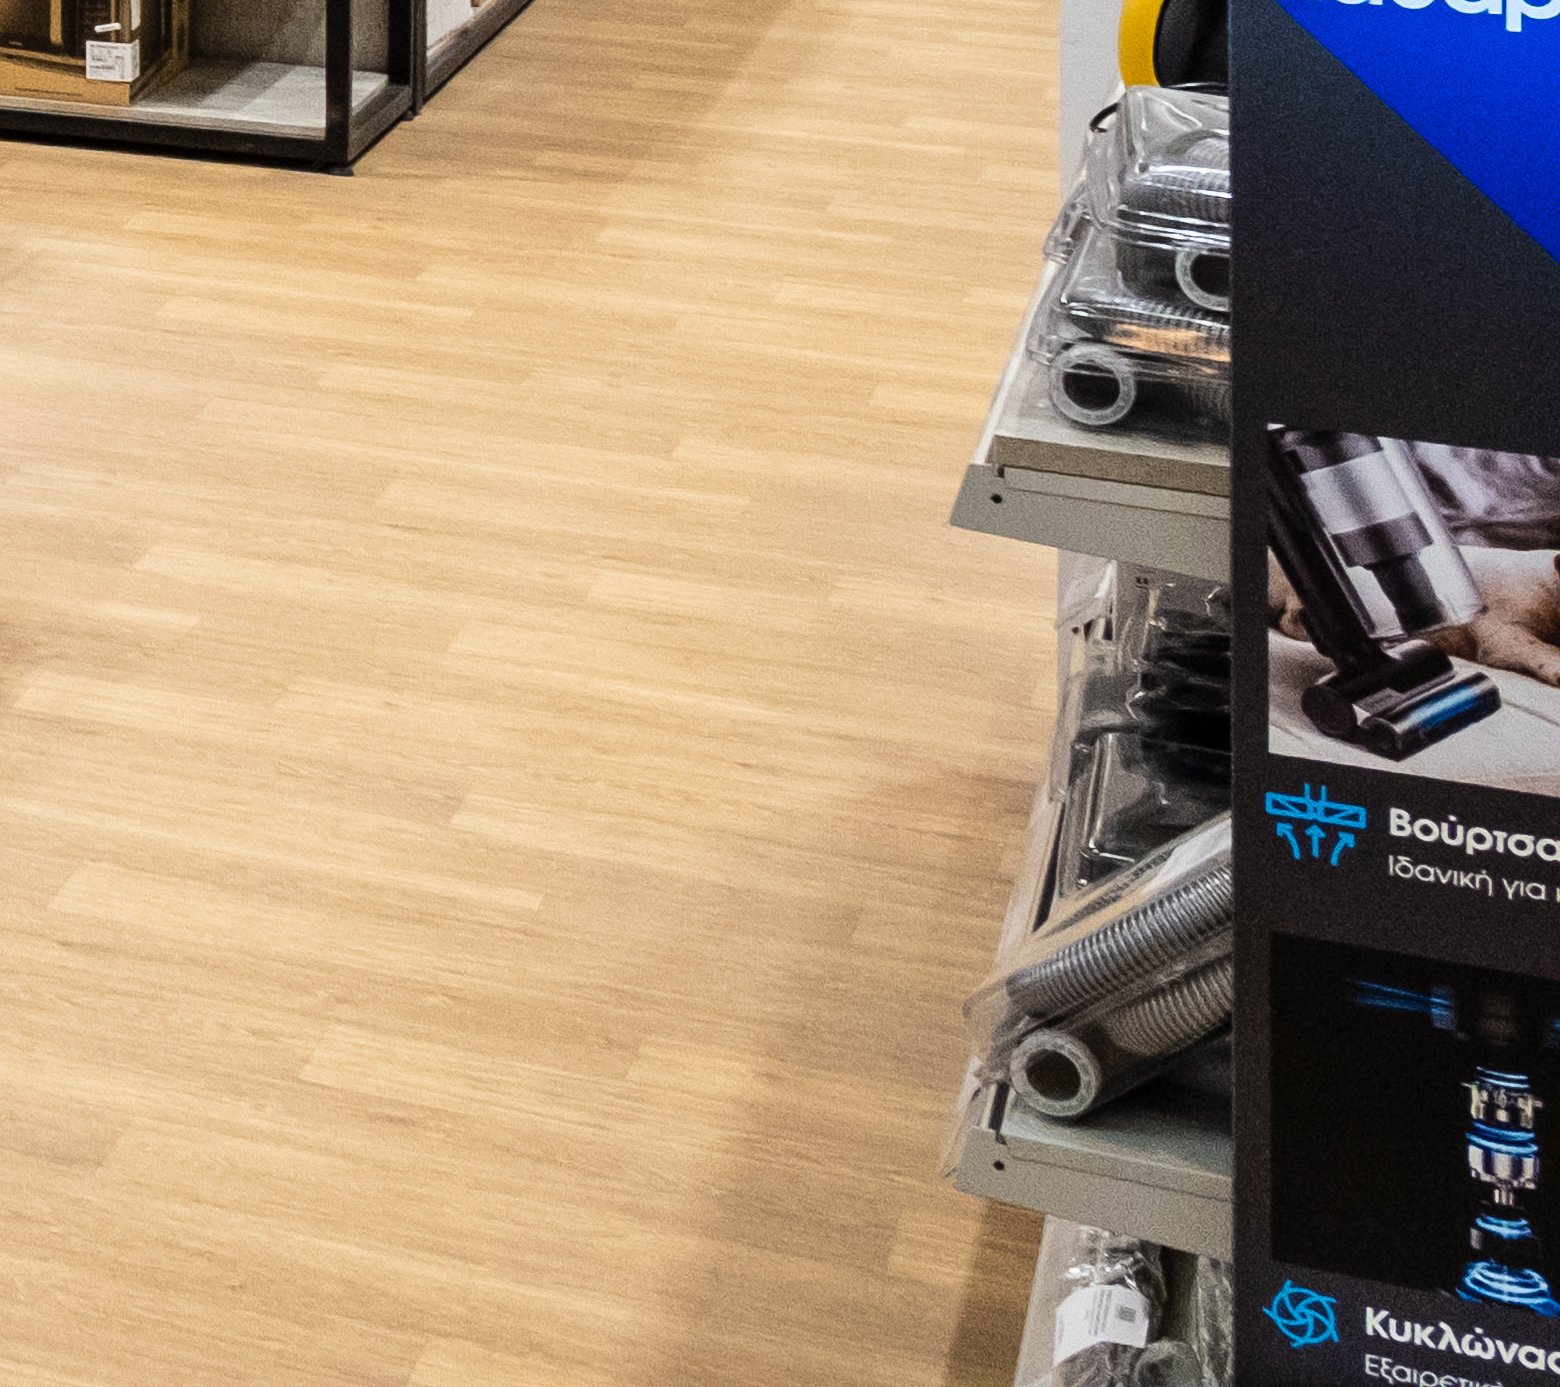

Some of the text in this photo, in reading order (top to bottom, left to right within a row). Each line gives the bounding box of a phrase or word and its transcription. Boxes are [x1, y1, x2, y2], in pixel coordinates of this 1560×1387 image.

[1388, 806, 1560, 862] Βούρτσα
[1387, 854, 1547, 901] Ιδανική για
